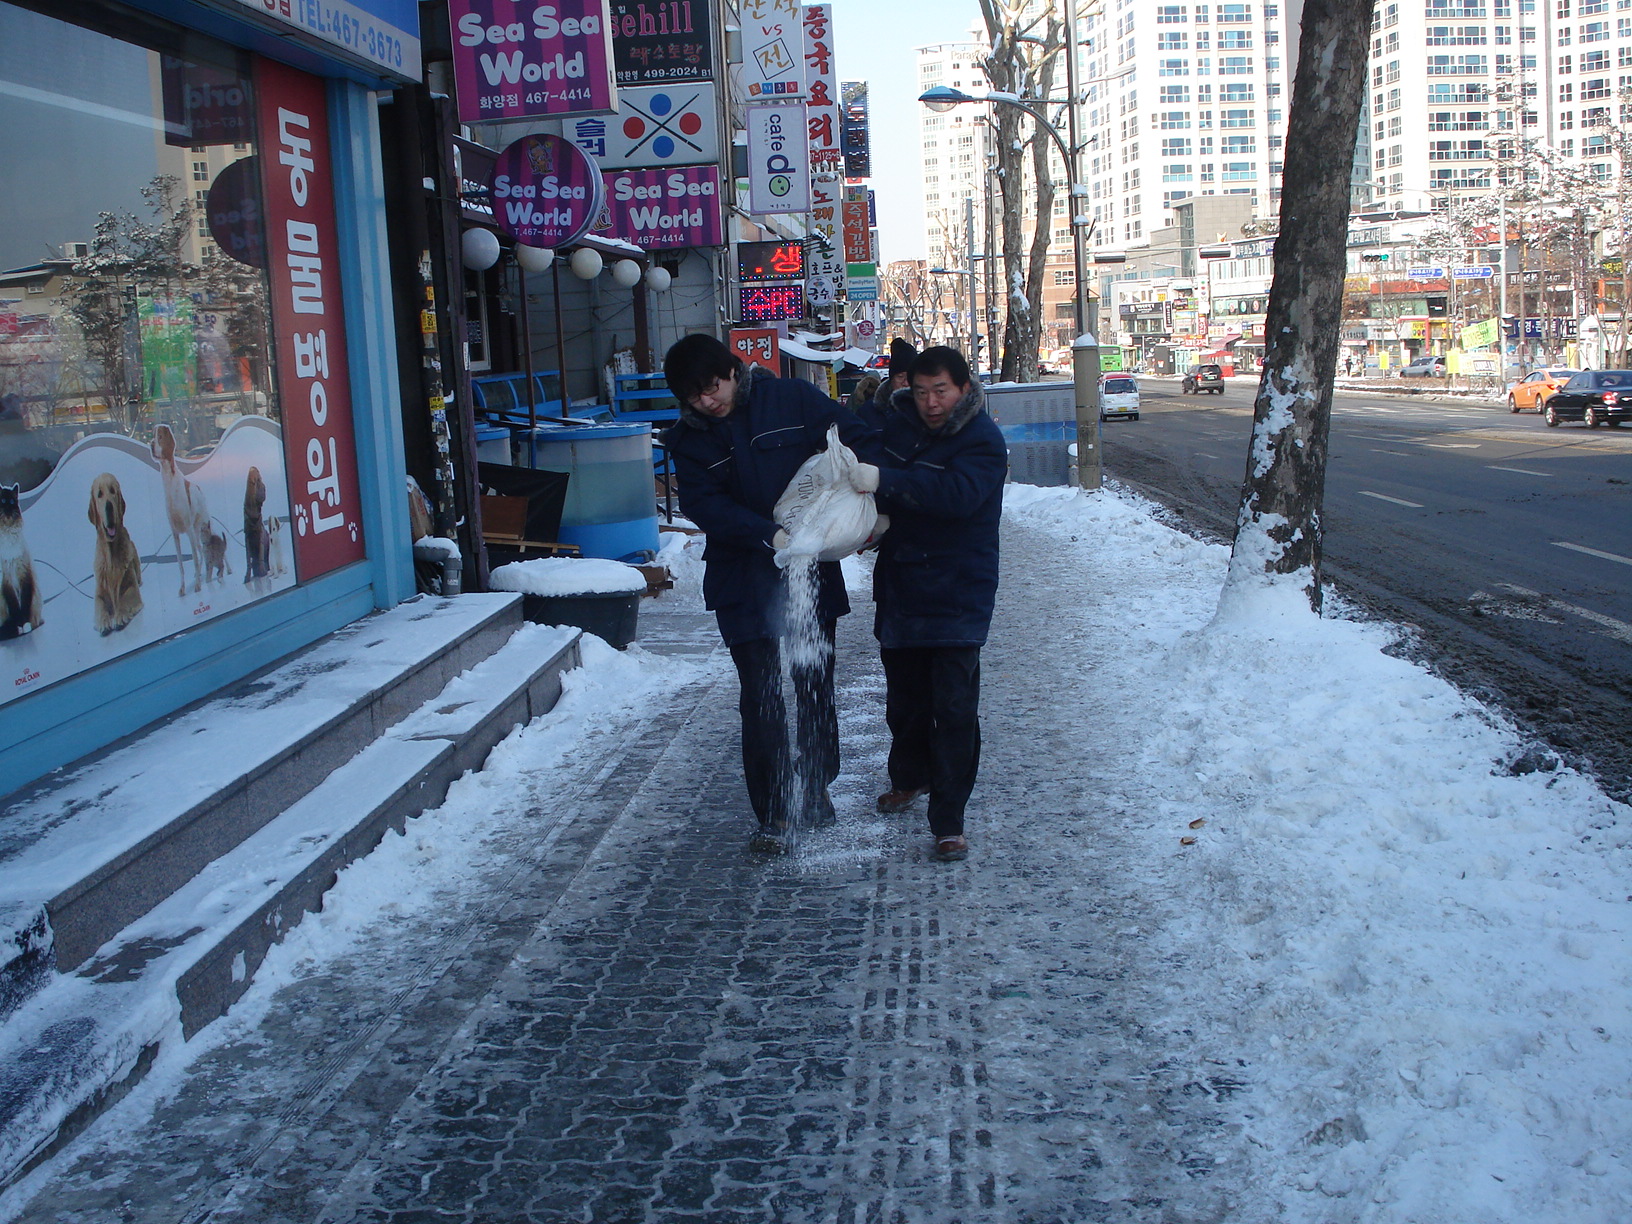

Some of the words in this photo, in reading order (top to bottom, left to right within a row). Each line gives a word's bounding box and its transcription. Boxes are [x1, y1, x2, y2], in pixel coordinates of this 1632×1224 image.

[458, 13, 525, 46] Sea
[532, 5, 600, 39] Sea
[479, 50, 585, 86] World
[758, 44, 790, 68] 전
[644, 66, 698, 79] 499-2024
[701, 68, 712, 77] B1
[803, 6, 835, 147] 중국요리
[479, 93, 519, 110] 화양점
[525, 88, 592, 105] 467-4414
[769, 114, 786, 151] cafe
[494, 174, 536, 198] Sea
[541, 175, 586, 200] Sea
[614, 176, 662, 201] Sea
[667, 173, 715, 198] Sea
[505, 201, 572, 227] World
[629, 205, 703, 231] World
[514, 227, 562, 237] T.467-4414
[637, 233, 685, 245] 467-4414
[811, 262, 832, 275] 호프
[807, 288, 829, 300] 국수
[278, 106, 344, 535] 동물병원
